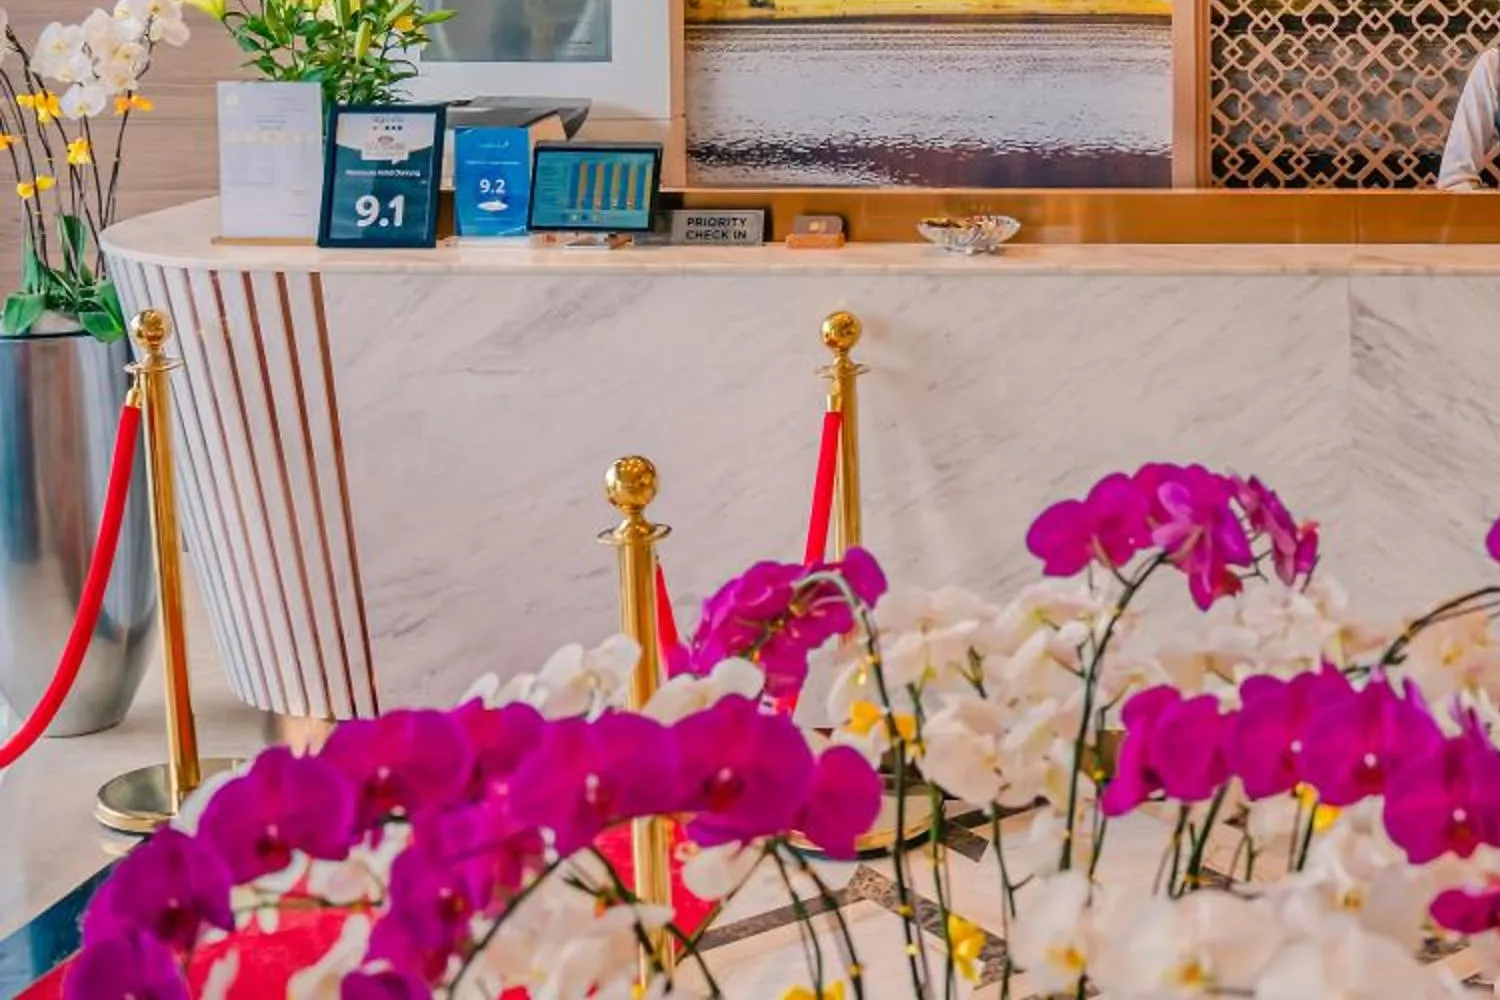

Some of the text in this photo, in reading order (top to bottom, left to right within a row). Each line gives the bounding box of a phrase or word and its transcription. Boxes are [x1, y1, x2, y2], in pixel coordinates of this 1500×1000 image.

[479, 179, 505, 194] 9.2
[355, 195, 405, 227] 9.1
[687, 217, 748, 227] PRIORITY
[685, 229, 747, 240] CHECK IN
